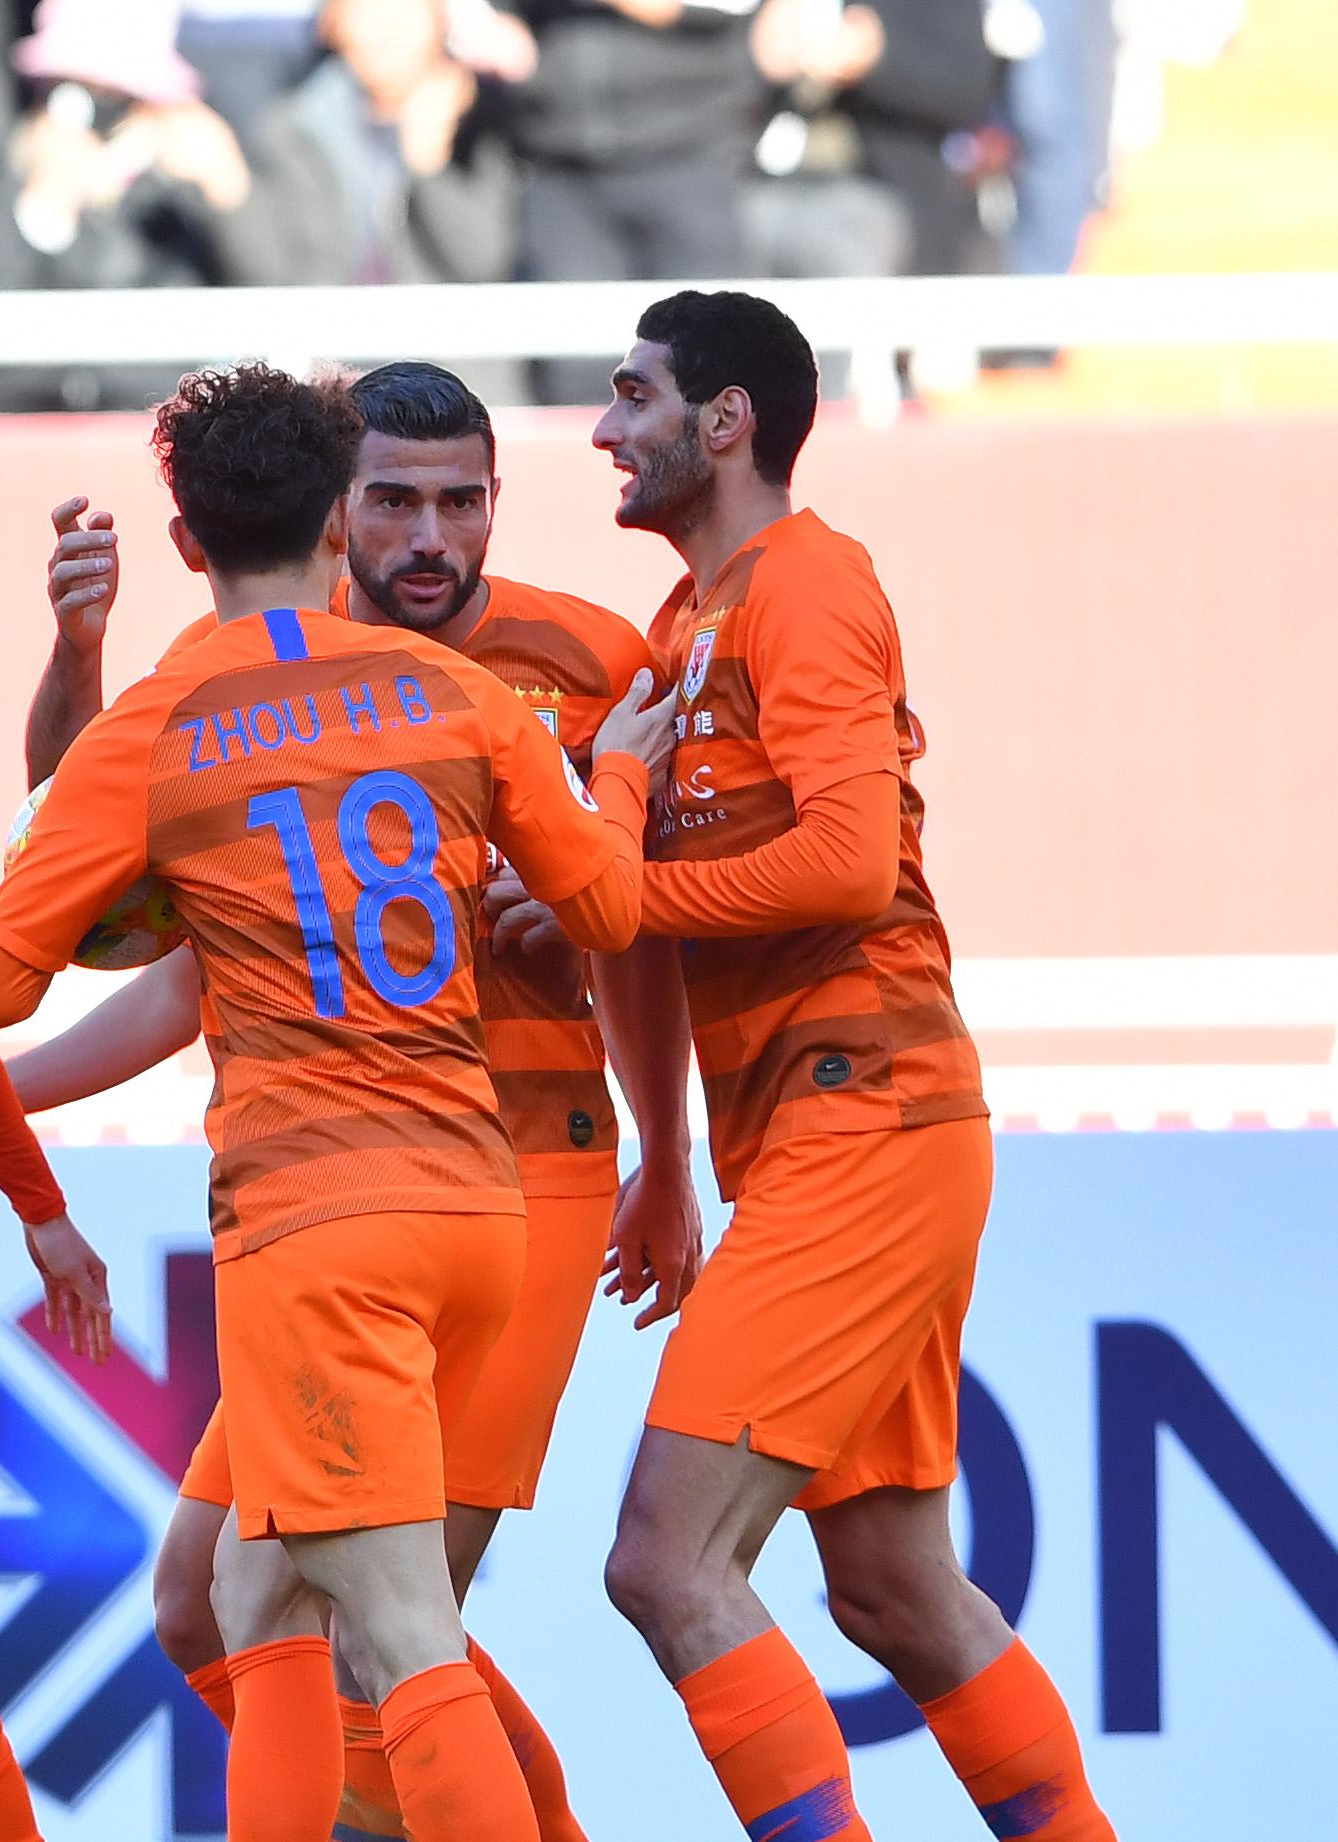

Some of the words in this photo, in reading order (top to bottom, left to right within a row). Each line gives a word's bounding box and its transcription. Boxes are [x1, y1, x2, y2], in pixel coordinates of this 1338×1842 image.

[178, 694, 322, 774] ZHOU
[681, 808, 727, 829] Care
[246, 769, 456, 1019] 18
